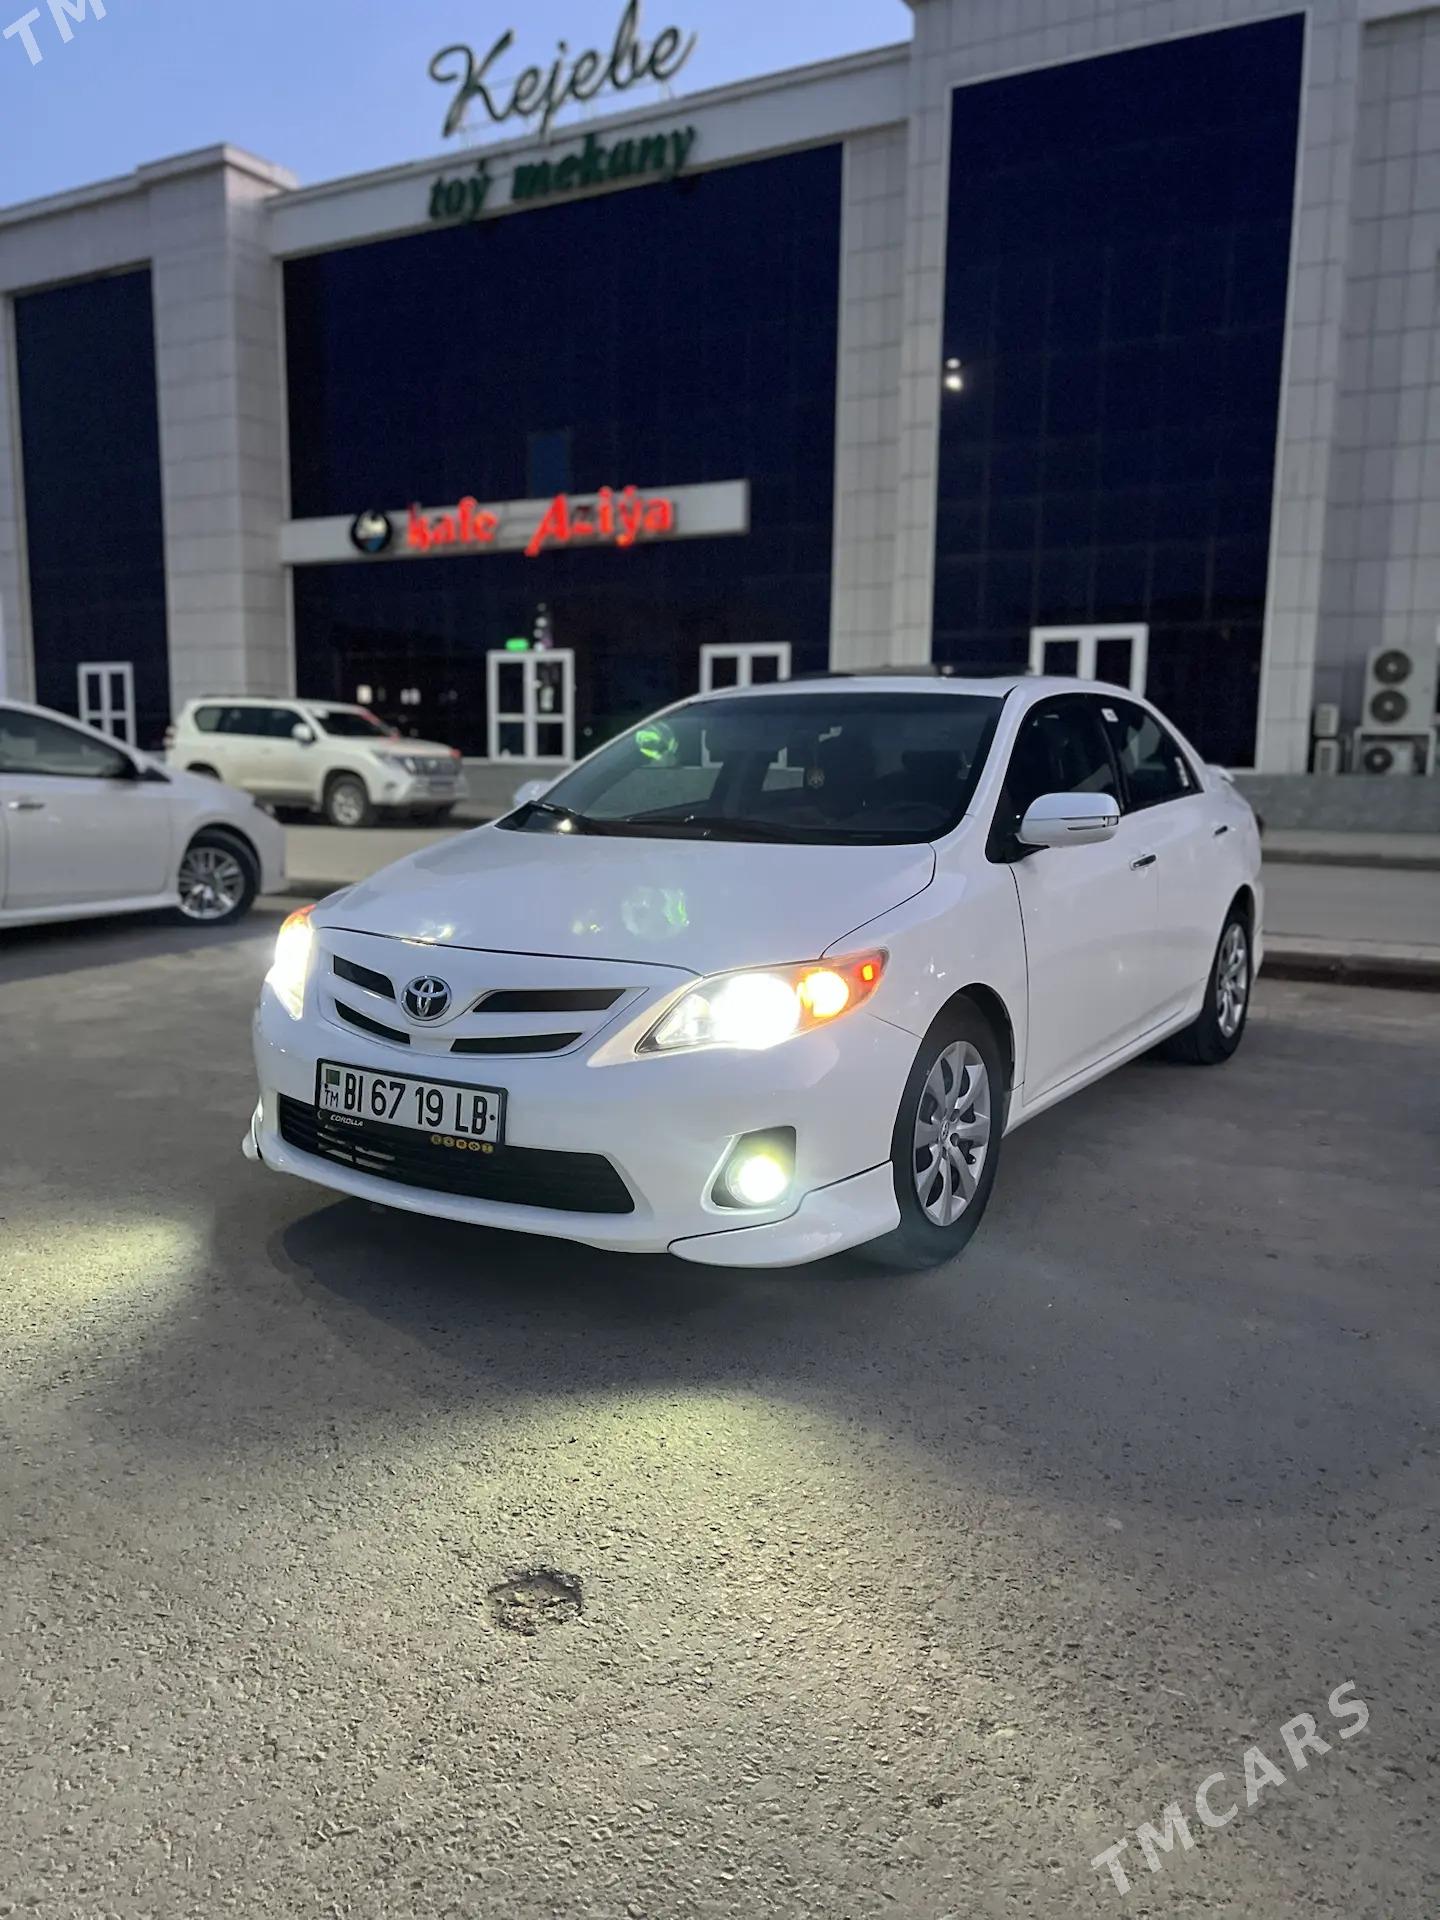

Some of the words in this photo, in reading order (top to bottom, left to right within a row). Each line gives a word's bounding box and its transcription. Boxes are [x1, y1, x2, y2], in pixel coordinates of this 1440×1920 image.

[429, 0, 696, 140] Kejebe
[511, 126, 695, 200] mekany
[324, 1090, 339, 1108] TM
[344, 1073, 364, 1112] BI
[371, 1079, 406, 1120] 67
[415, 1086, 444, 1127] 19
[455, 1093, 488, 1135] LB
[330, 1114, 364, 1127] COROLLA
